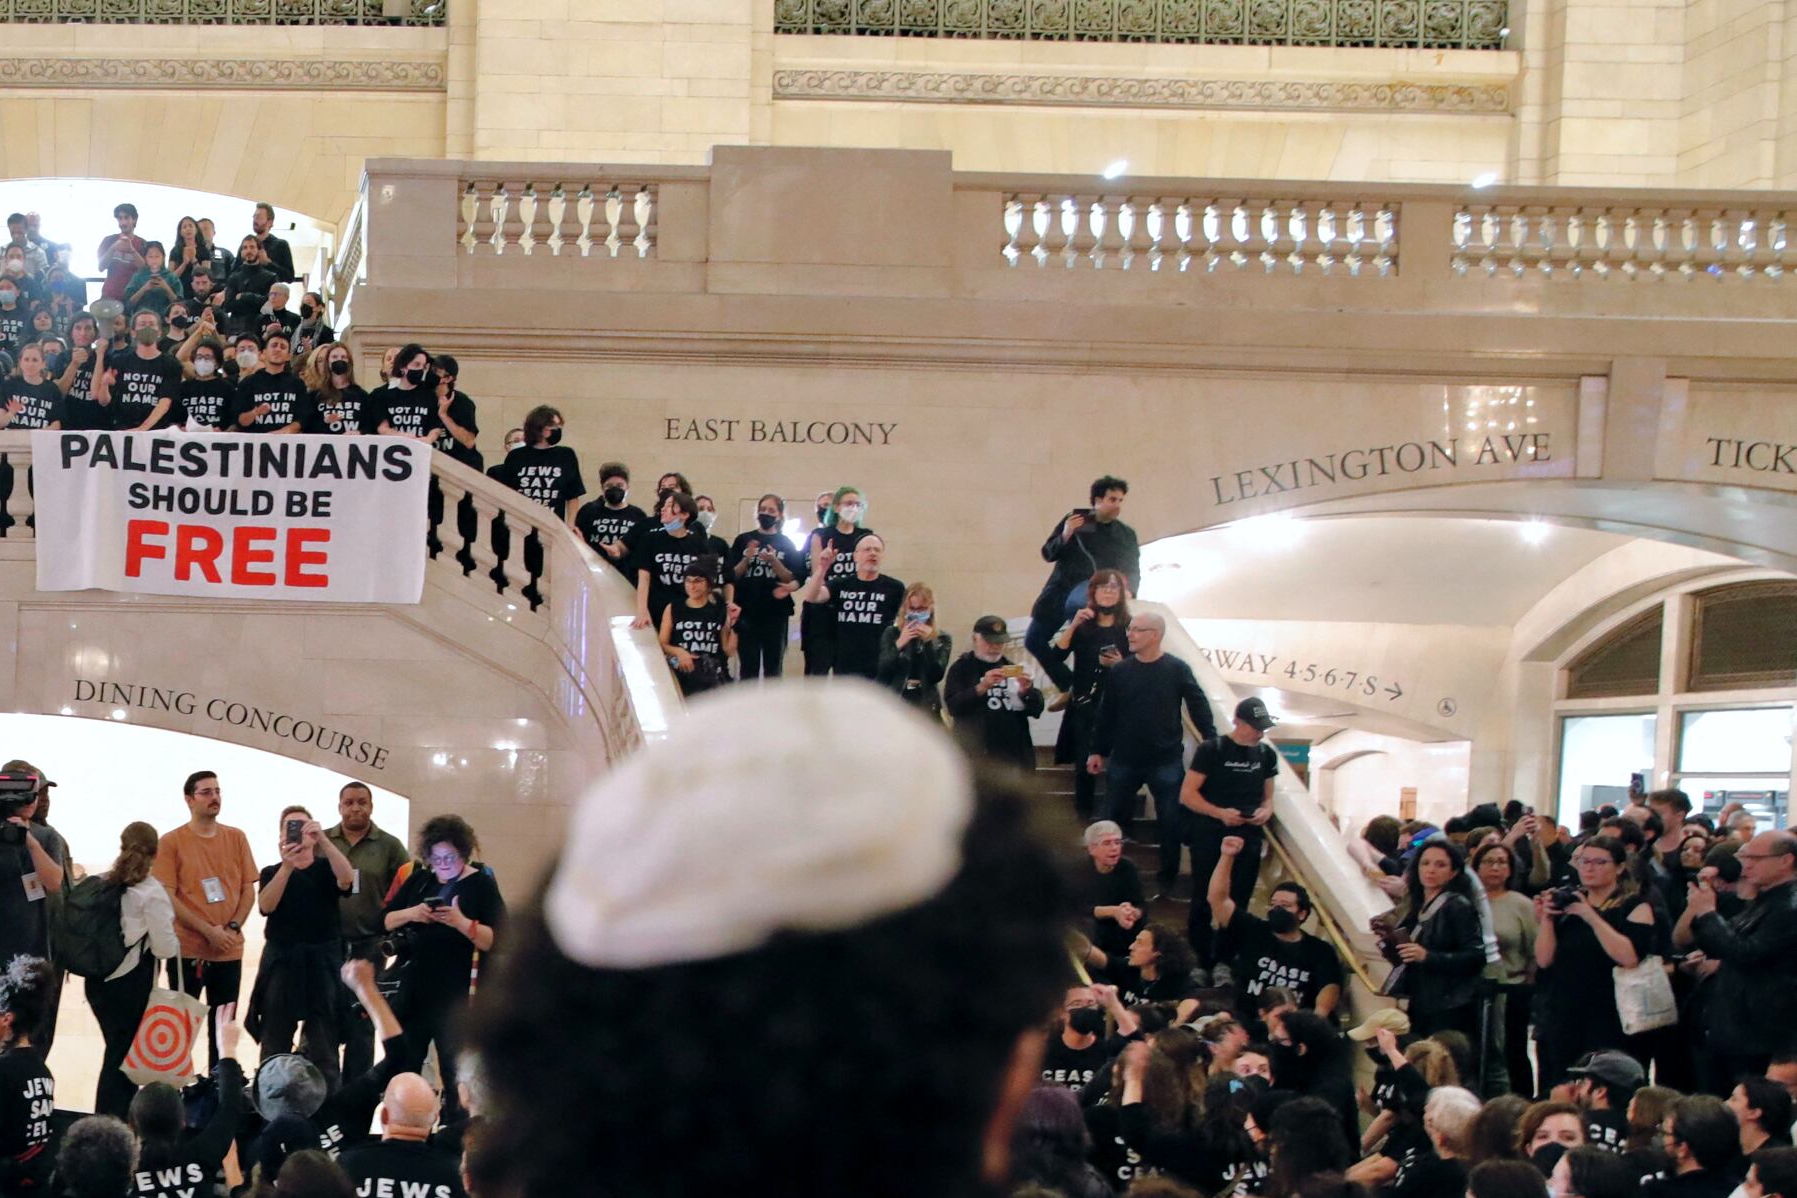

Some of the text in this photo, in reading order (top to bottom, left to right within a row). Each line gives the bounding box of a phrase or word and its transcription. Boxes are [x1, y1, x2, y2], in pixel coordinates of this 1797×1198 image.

[123, 372, 149, 382] NOT
[128, 383, 156, 393] OUR
[122, 393, 159, 406] NAME
[182, 396, 224, 407] CEASE
[254, 393, 296, 402] NOT IN
[41, 399, 53, 410] IN
[268, 402, 290, 412] UR
[415, 406, 428, 415] IN
[255, 413, 293, 425] NAME
[393, 414, 422, 425] OUR
[329, 420, 359, 431] OW
[665, 418, 898, 445] EAST BALCONY
[60, 434, 413, 482] PALESTINIANS
[1706, 438, 1797, 474] TICK
[517, 466, 562, 477] JEWS
[1209, 432, 1552, 506] LEXINGTON AVE
[520, 477, 555, 488] SAY
[128, 482, 332, 518] SHOULD BE
[590, 534, 626, 544] NAM
[124, 519, 331, 588] FREE
[655, 553, 697, 564] CEAS
[836, 552, 852, 561] OT
[833, 562, 854, 573] OU
[659, 573, 685, 586] NO
[839, 590, 885, 602] NOT IN
[843, 601, 877, 612] OUR
[838, 611, 883, 624] NAME
[74, 679, 389, 771] DINING CONCOURSE
[1042, 1069, 1095, 1083] CEAS
[23, 1077, 54, 1099] JEW
[135, 1162, 204, 1192] EWS
